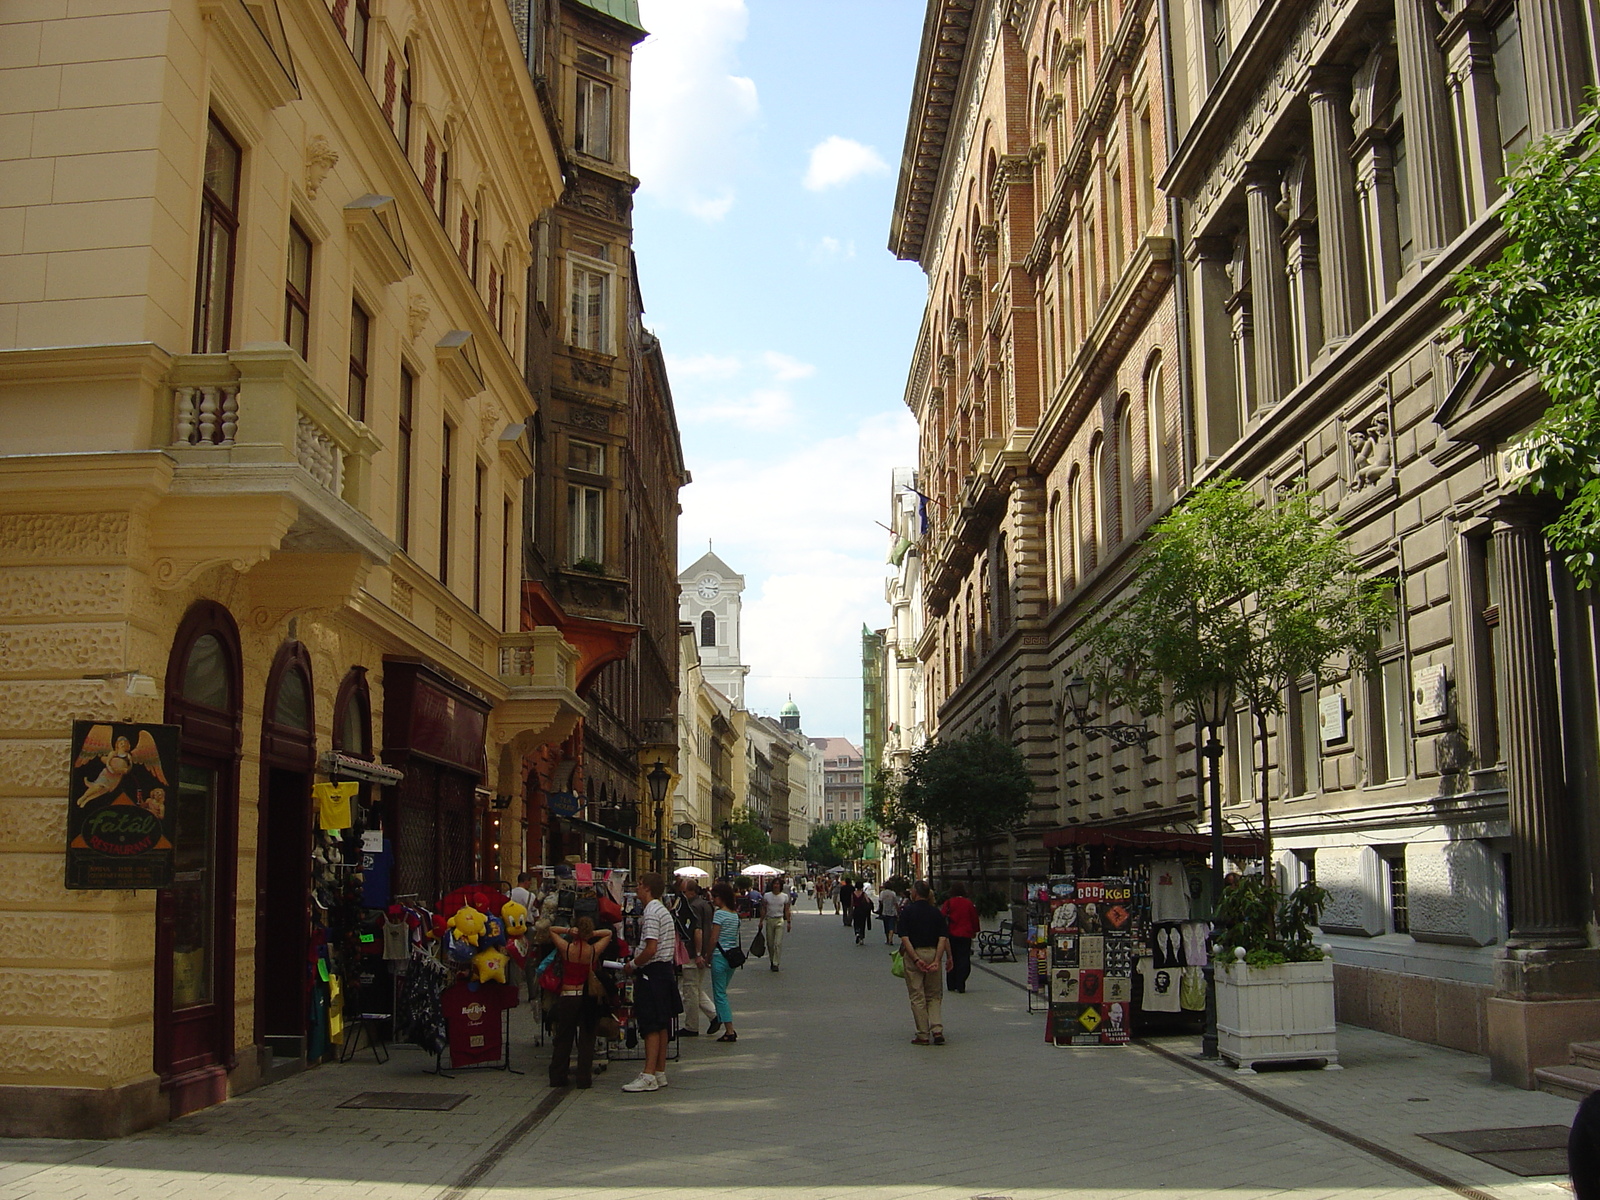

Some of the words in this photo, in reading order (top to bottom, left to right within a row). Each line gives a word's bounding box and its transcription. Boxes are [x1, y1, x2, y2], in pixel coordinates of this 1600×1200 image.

[91, 835, 152, 854] RESTAURANT
[1078, 886, 1104, 899] СССР
[474, 1005, 486, 1013] Rock
